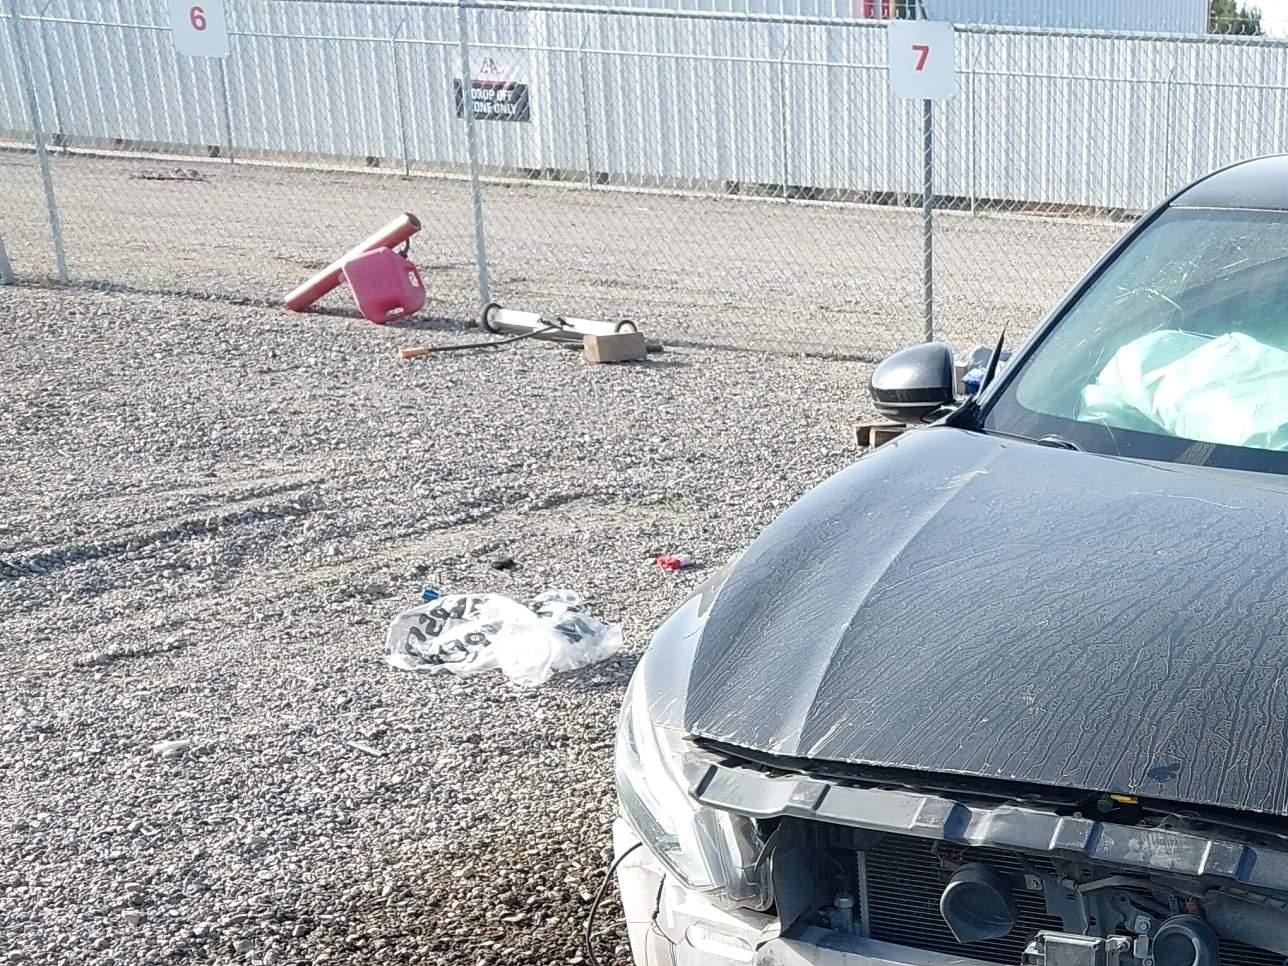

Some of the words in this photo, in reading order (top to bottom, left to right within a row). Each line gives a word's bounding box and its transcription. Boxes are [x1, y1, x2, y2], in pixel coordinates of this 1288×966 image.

[190, 6, 207, 31] 6
[912, 44, 929, 71] 7
[471, 88, 495, 100] DROP
[497, 90, 512, 101] OFF
[473, 101, 492, 114] ONE
[494, 102, 516, 115] ONLY
